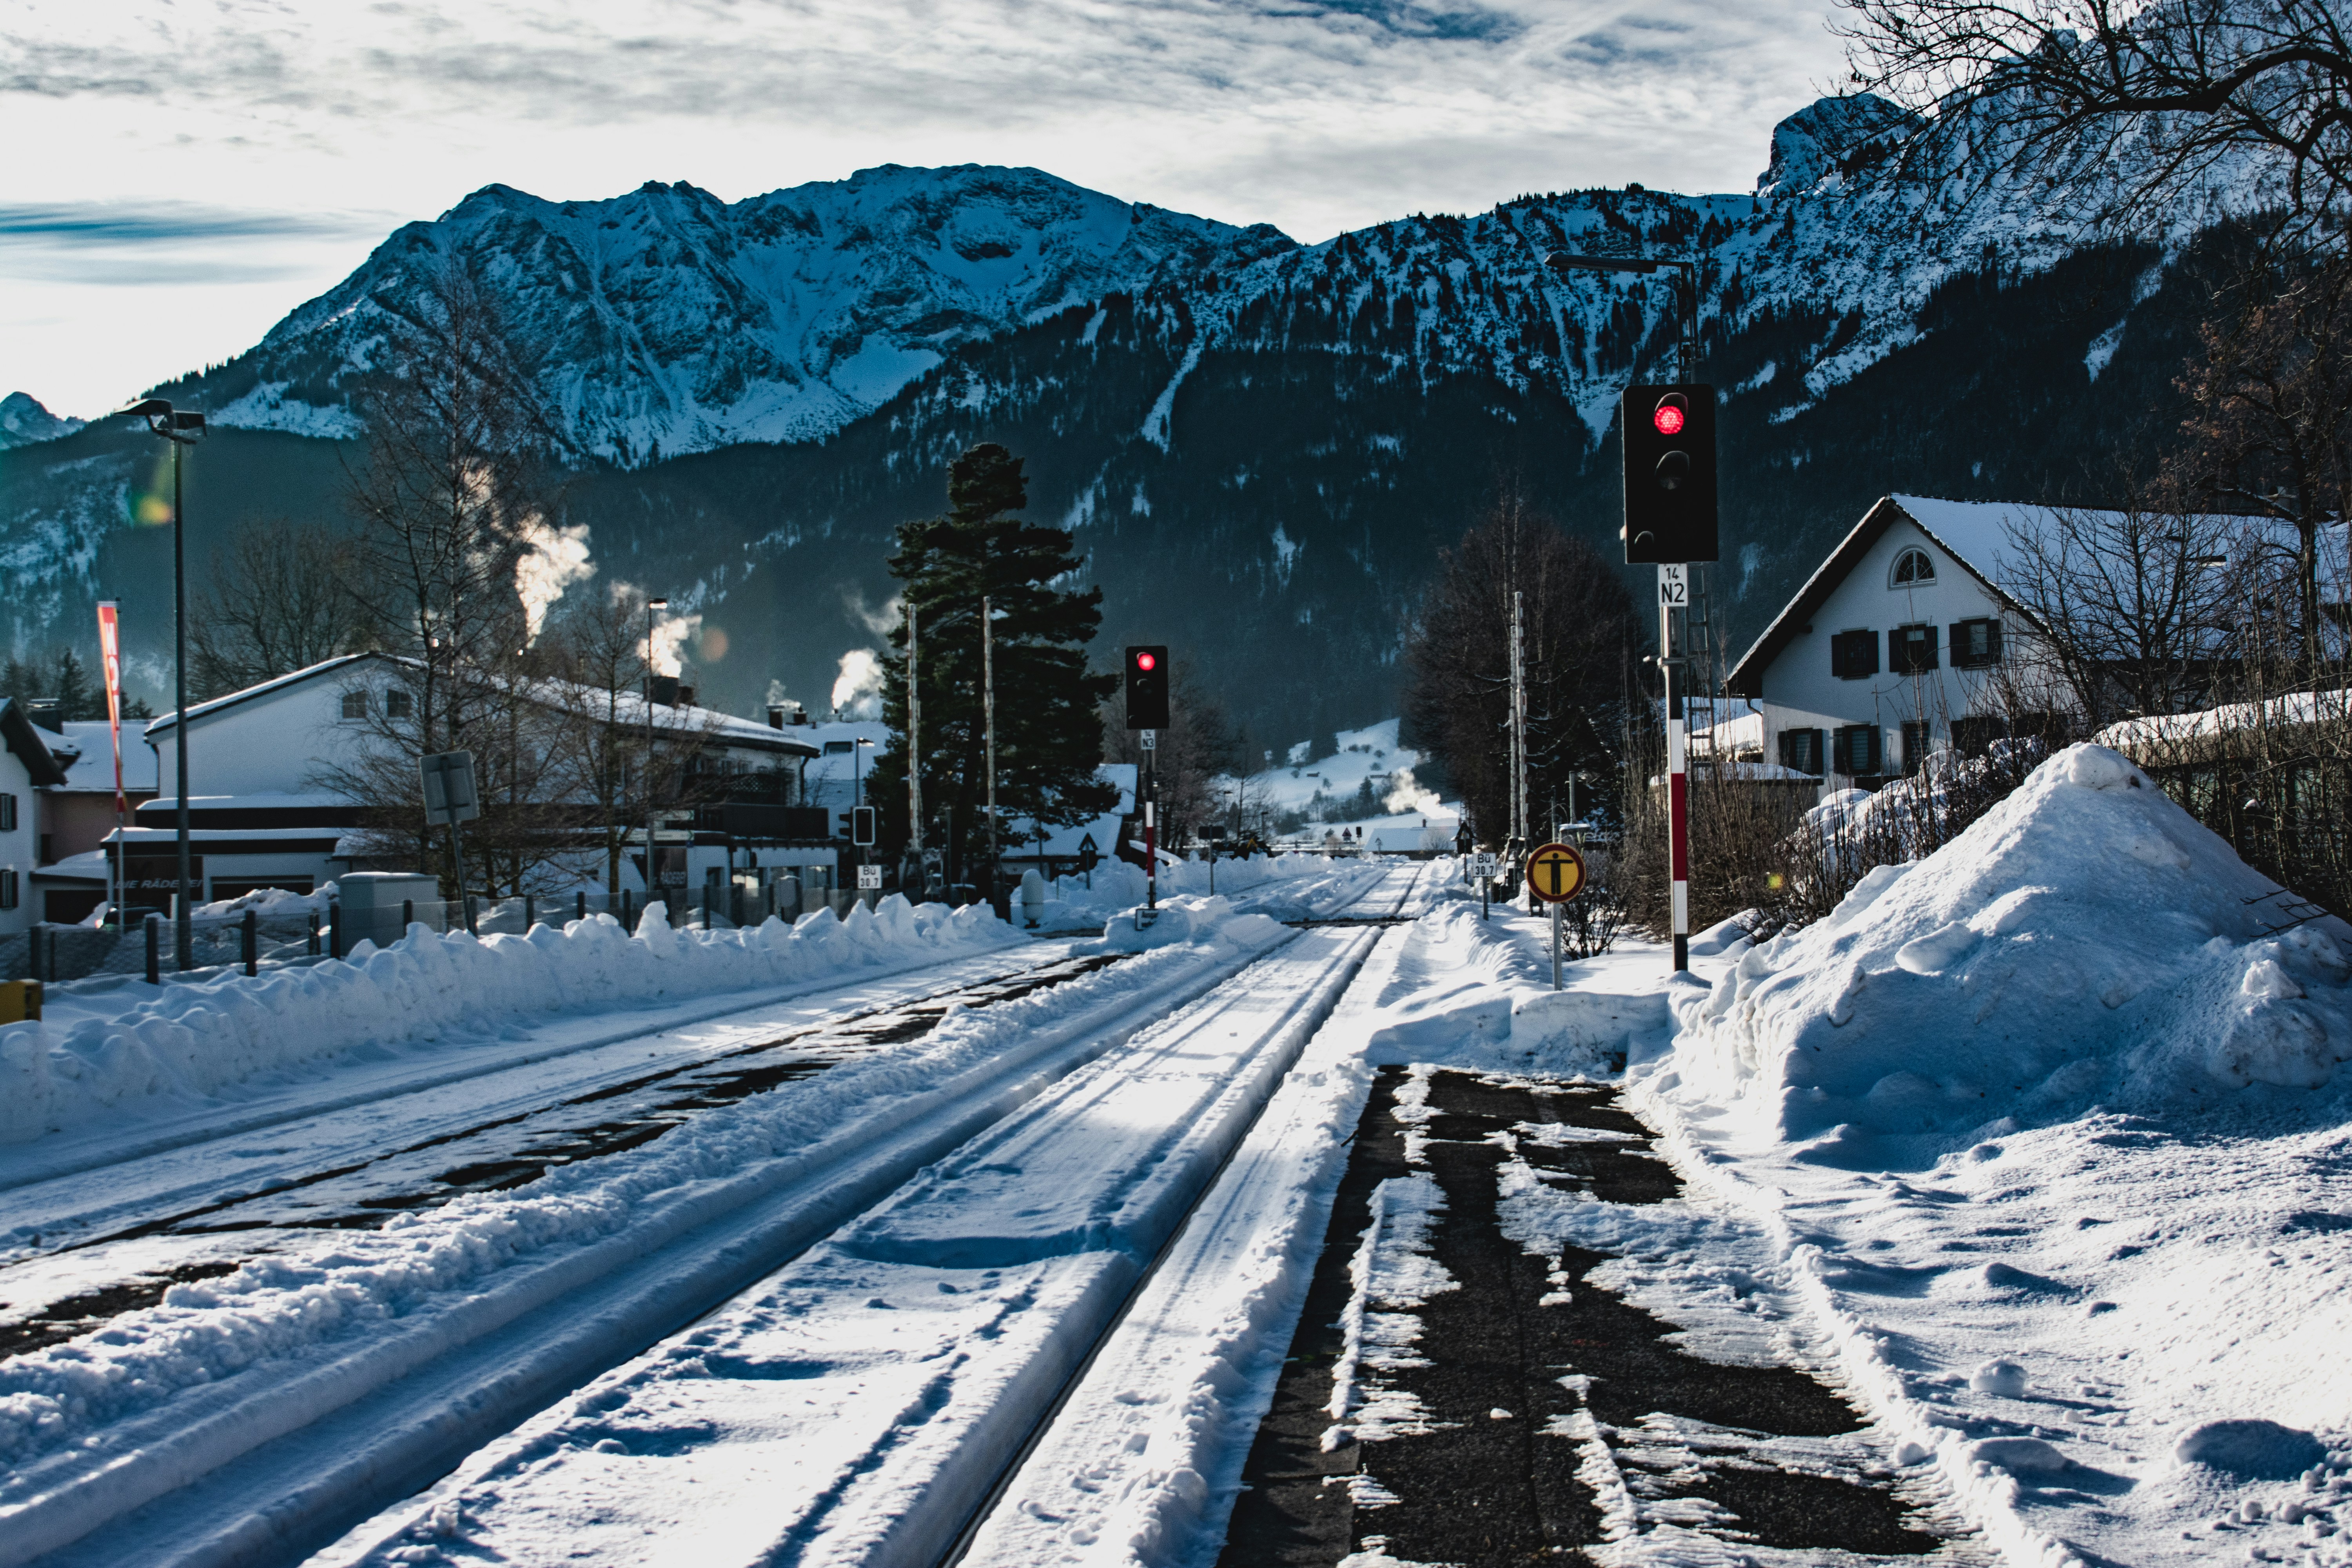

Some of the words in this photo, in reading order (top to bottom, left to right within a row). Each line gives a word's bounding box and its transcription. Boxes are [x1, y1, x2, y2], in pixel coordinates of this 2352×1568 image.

[1666, 567, 1680, 580] 14
[1662, 583, 1684, 603] N2
[1142, 738, 1154, 748] N3
[1477, 854, 1490, 864] Bü
[863, 865, 876, 875] Bü
[1475, 866, 1494, 875] 30.7
[140, 878, 203, 889] RÄDEEI
[860, 878, 878, 887] 30.7
